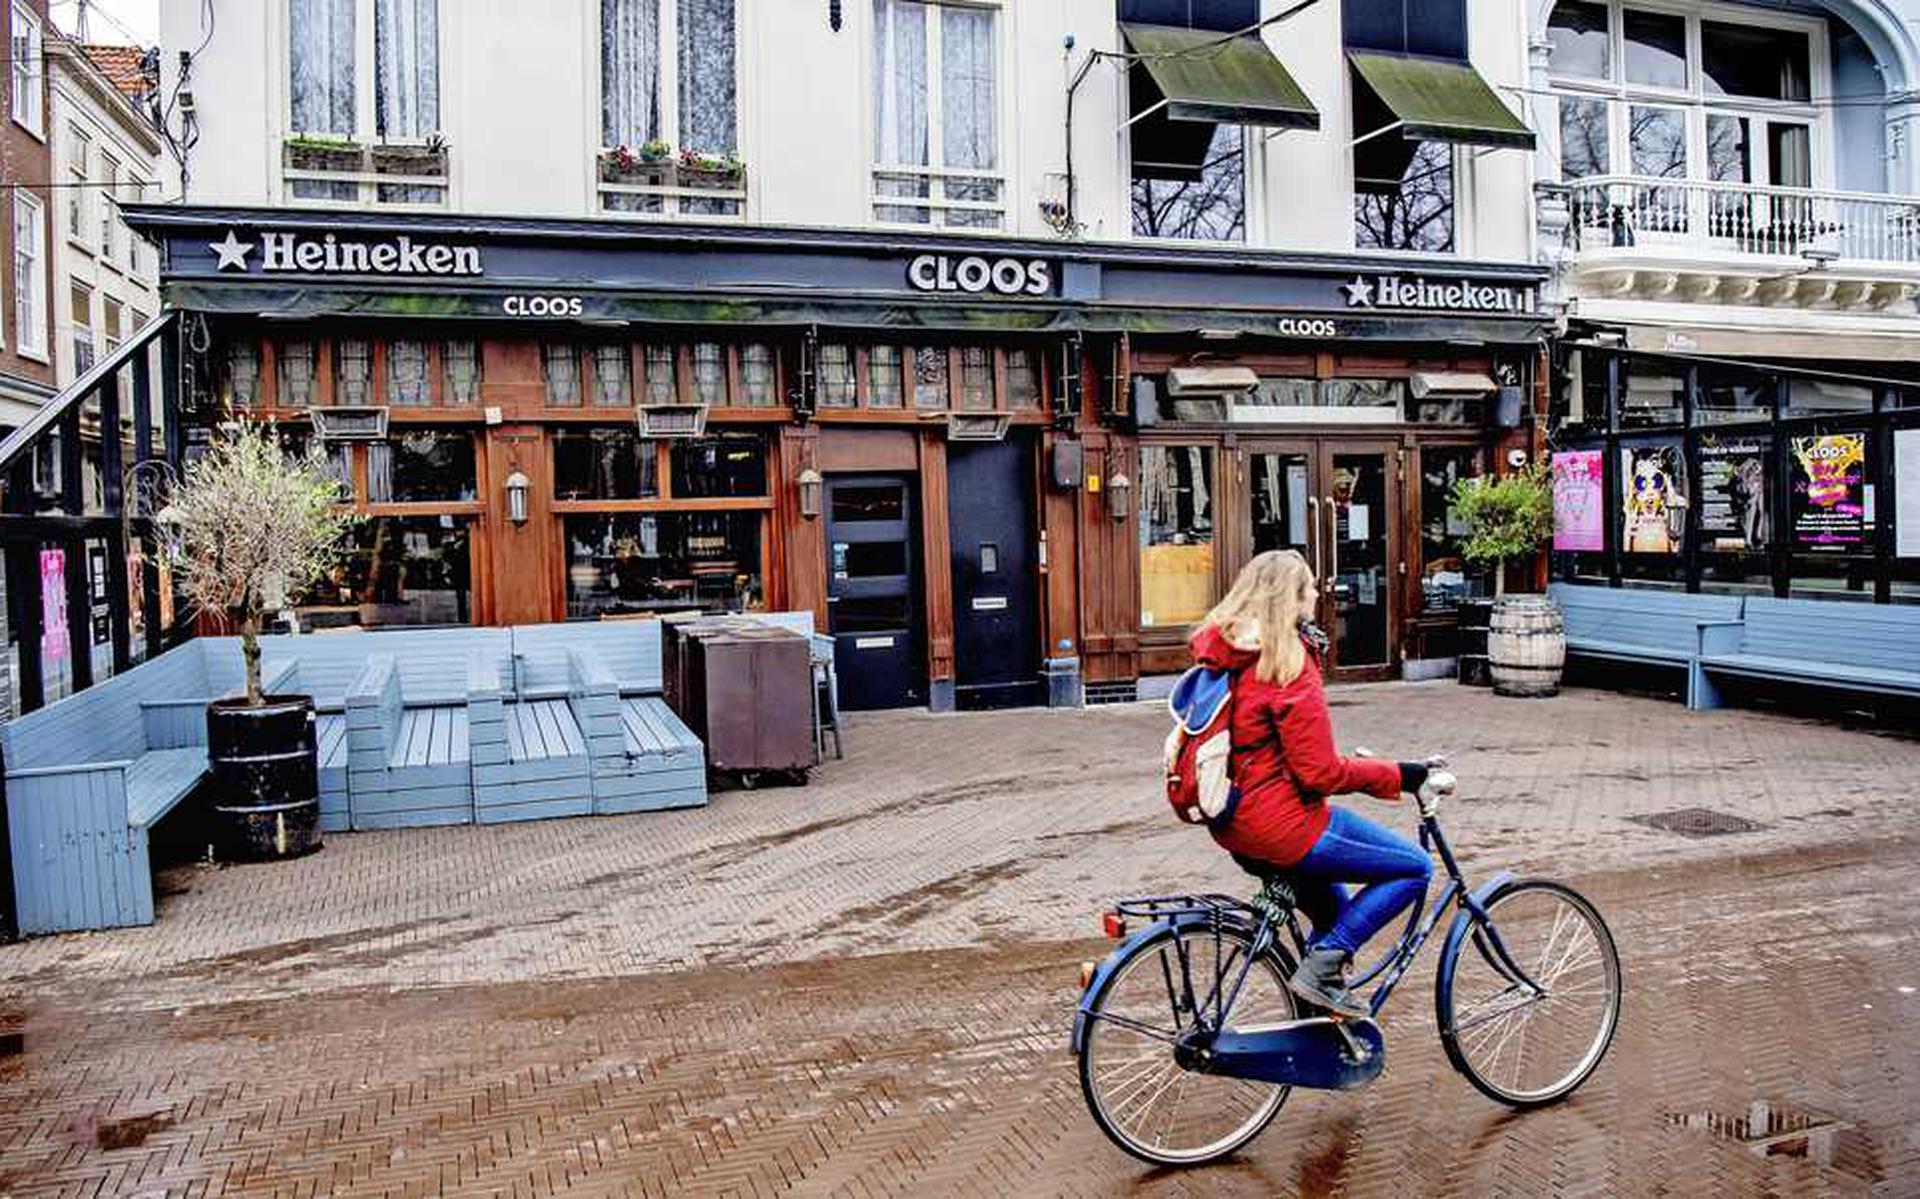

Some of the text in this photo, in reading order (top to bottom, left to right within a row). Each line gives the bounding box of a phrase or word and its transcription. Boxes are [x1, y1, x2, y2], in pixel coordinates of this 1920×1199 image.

[260, 232, 484, 275] Heineken
[909, 254, 1050, 294] CLOOS
[503, 296, 583, 317] CLOOS
[1376, 276, 1513, 310] Heineken
[1279, 318, 1336, 337] CLOOS
